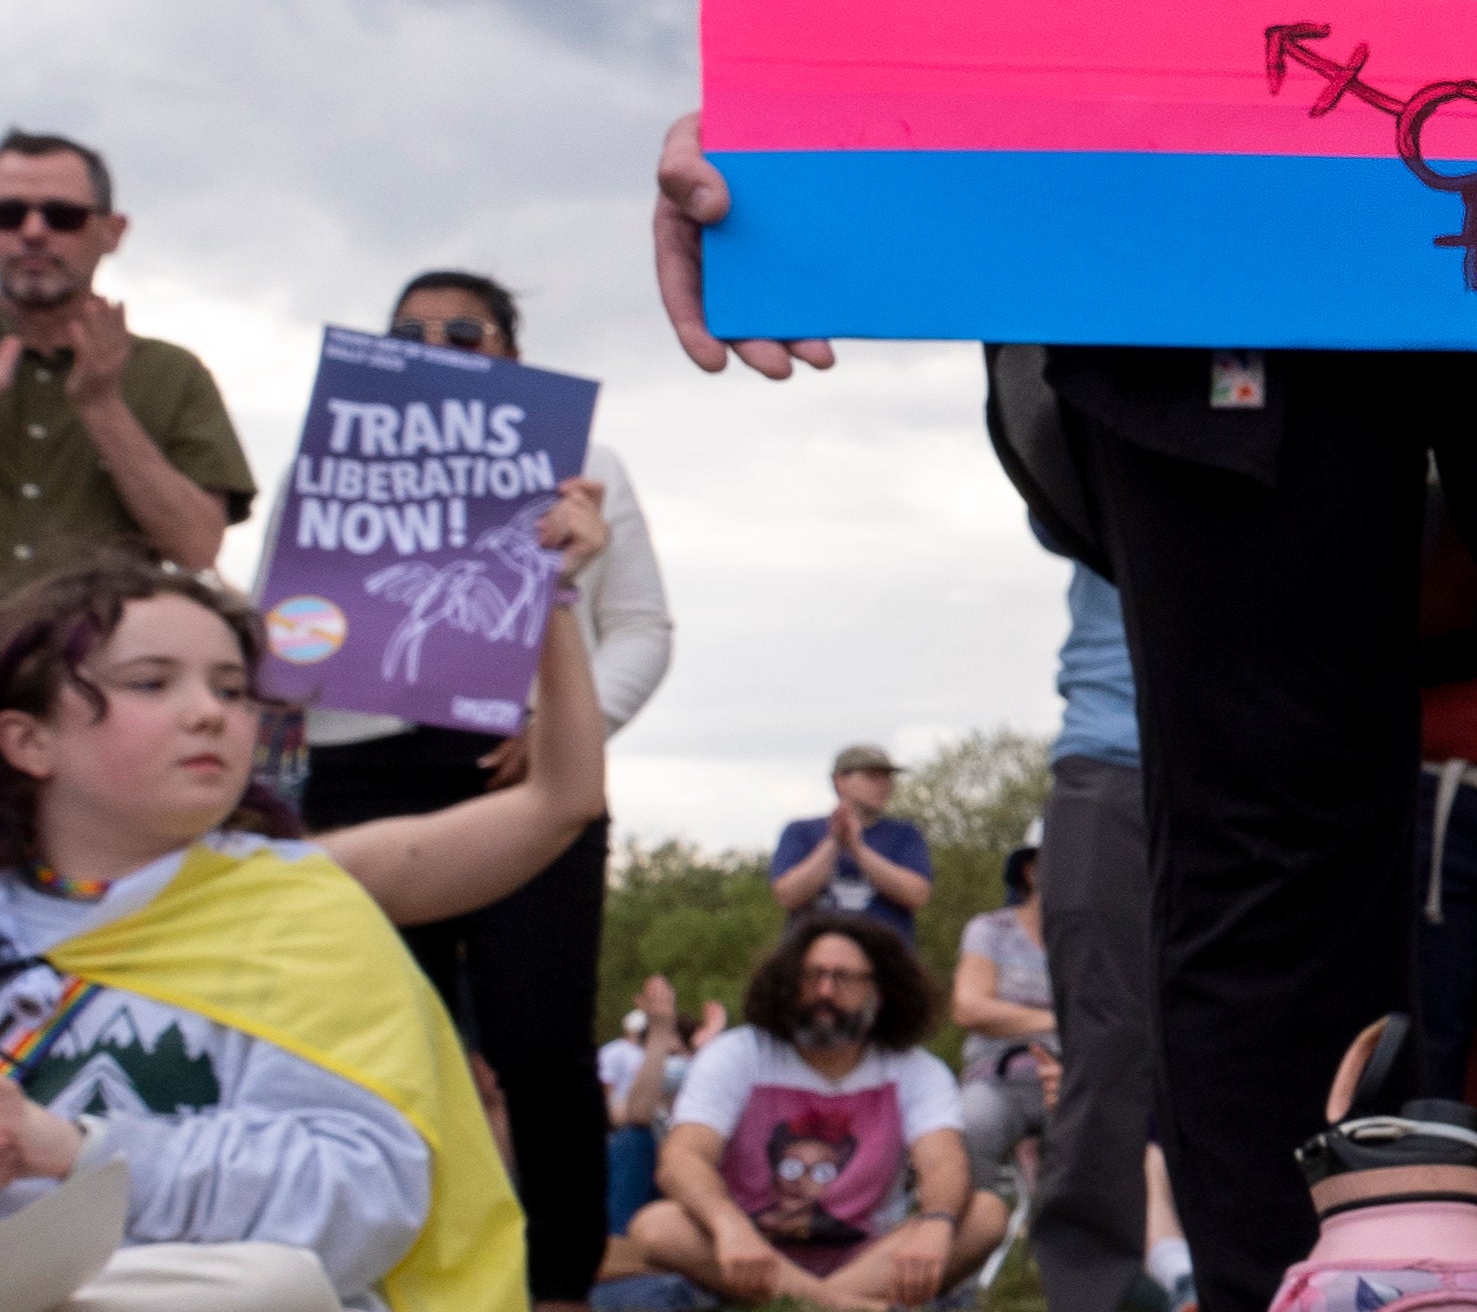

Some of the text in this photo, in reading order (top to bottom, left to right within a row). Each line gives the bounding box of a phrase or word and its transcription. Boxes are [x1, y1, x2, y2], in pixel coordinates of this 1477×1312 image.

[328, 399, 525, 455] TRANS
[296, 450, 554, 499] LIBERATION
[297, 498, 467, 554] NOW!
